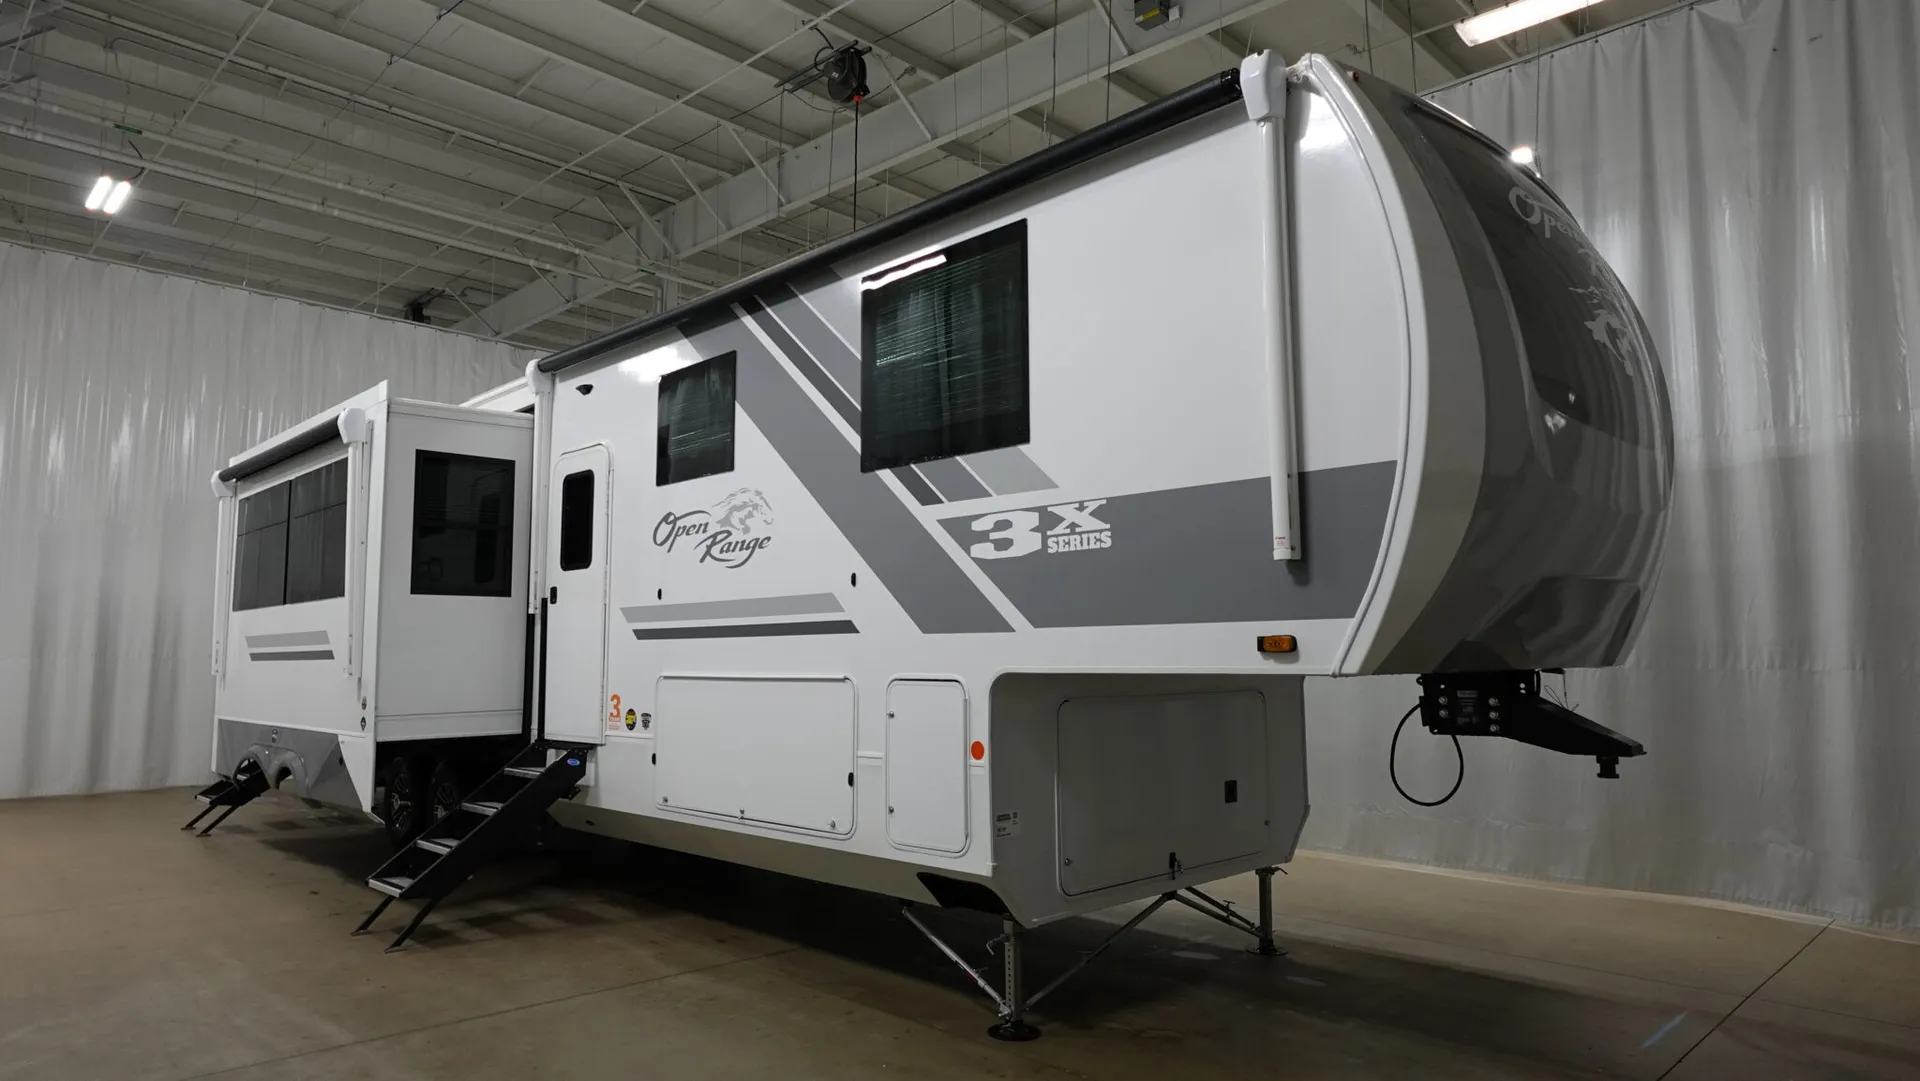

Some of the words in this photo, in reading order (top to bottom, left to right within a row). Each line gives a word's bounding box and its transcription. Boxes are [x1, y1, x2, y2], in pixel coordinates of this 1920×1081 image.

[652, 510, 712, 553] Open
[693, 529, 771, 569] Range
[970, 510, 1042, 560] 3
[1047, 499, 1111, 536] X
[1047, 531, 1112, 553] SERIES
[609, 694, 621, 718] 3
